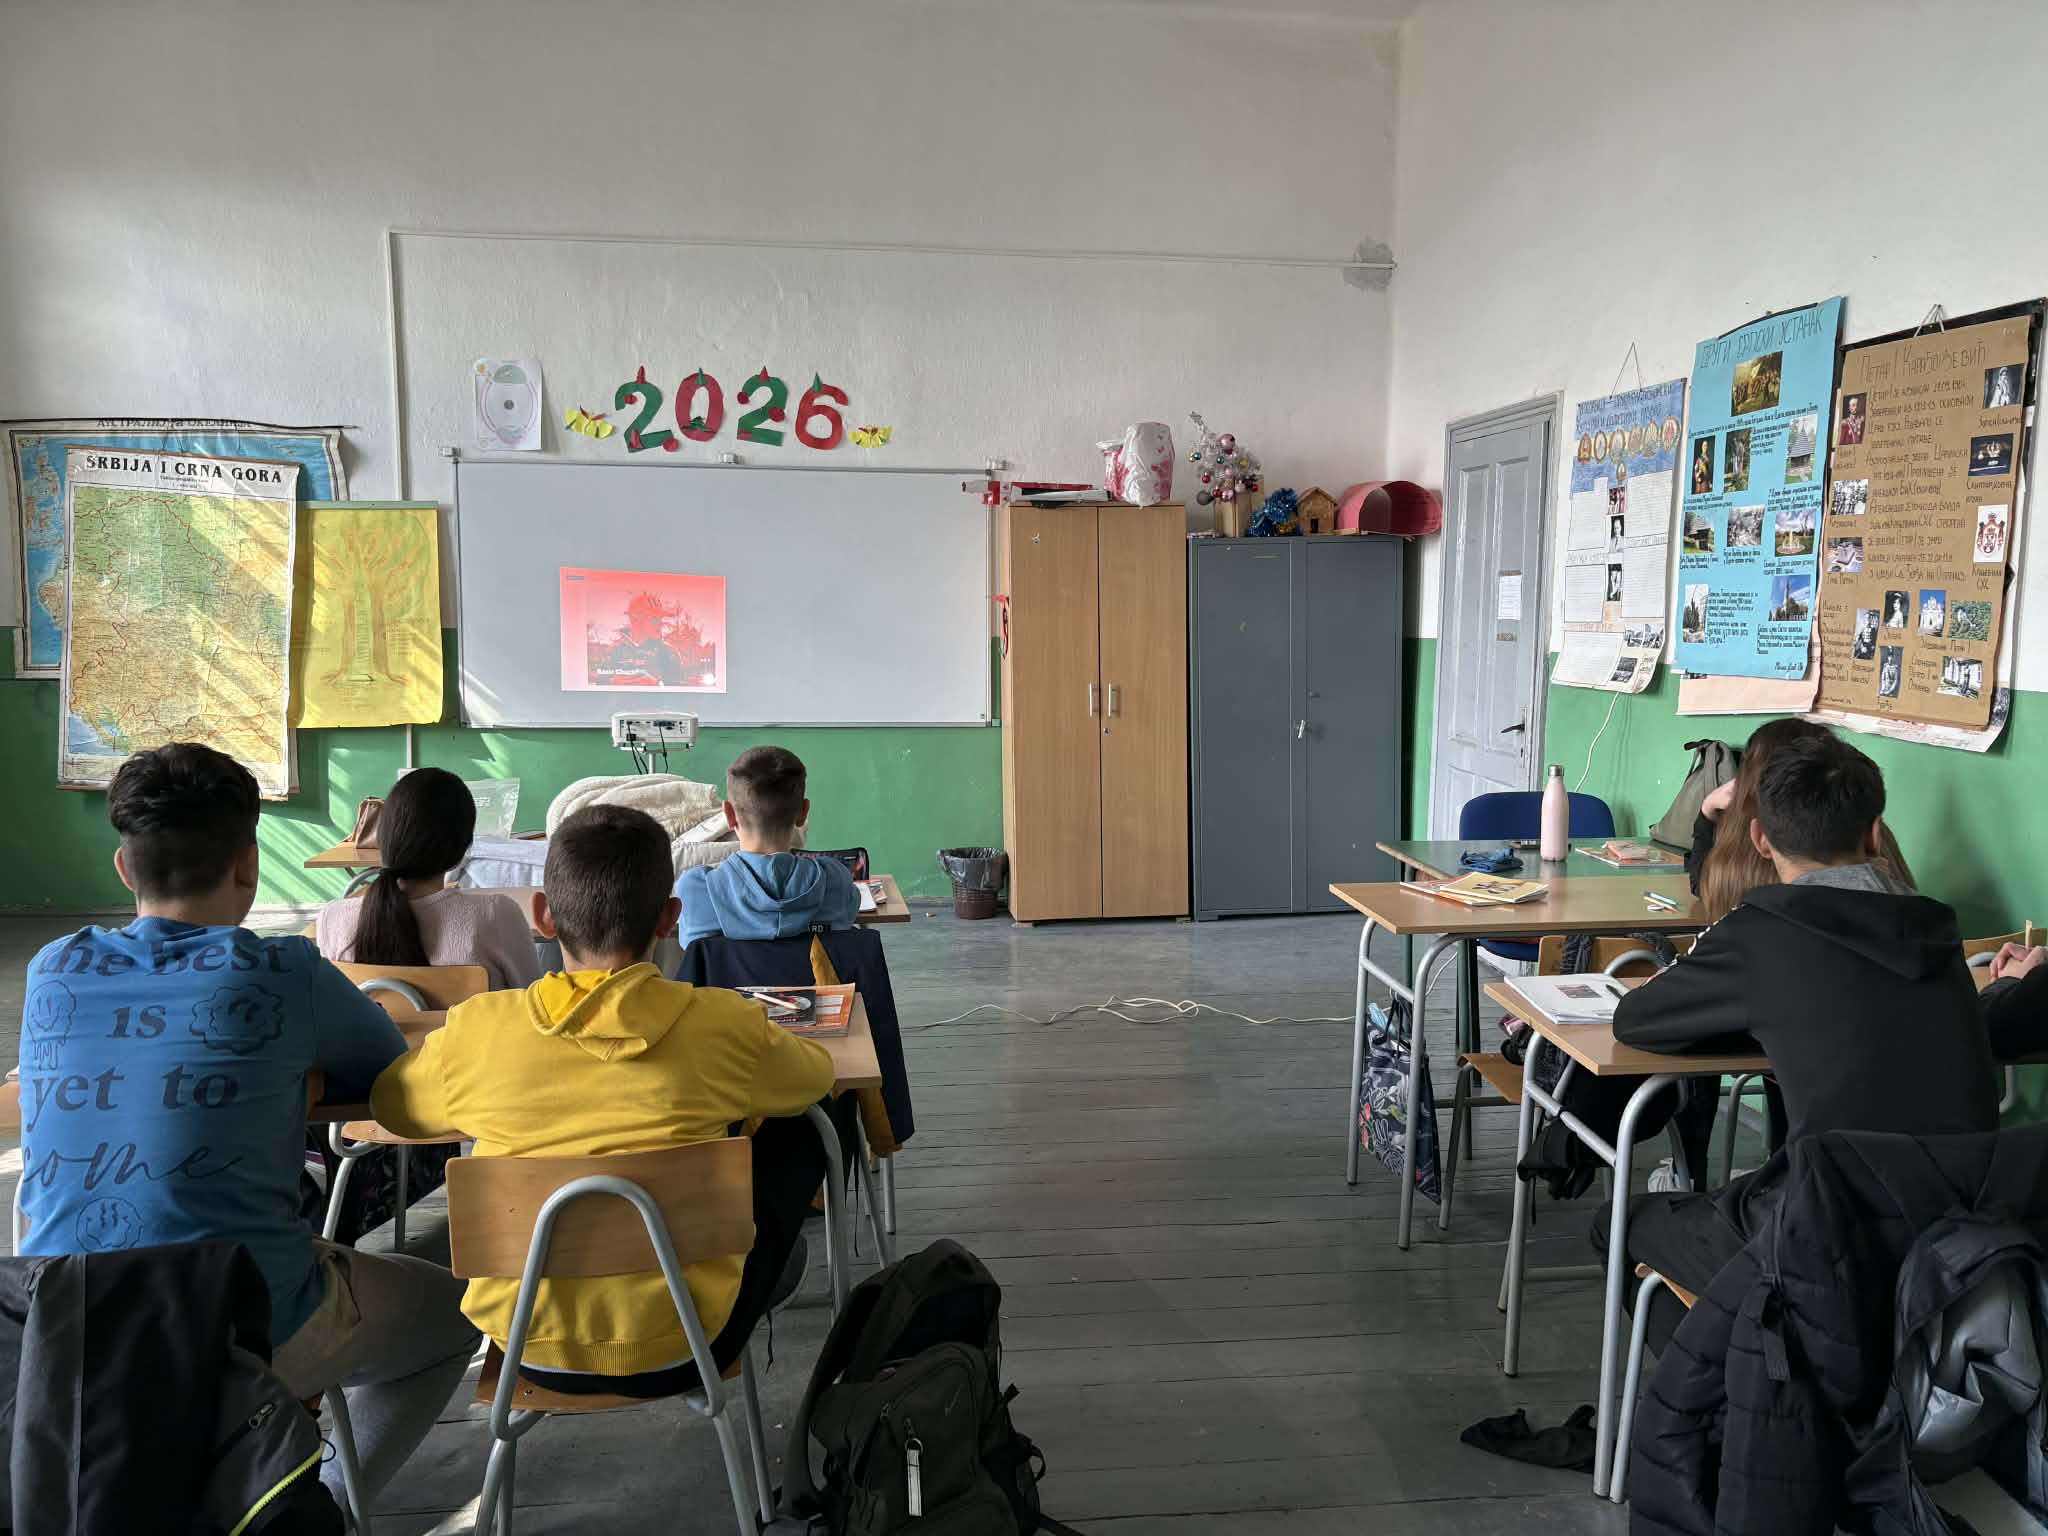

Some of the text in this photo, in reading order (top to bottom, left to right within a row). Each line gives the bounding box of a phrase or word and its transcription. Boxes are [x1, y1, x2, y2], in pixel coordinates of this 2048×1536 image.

[614, 368, 849, 453] 2026
[86, 455, 281, 483] SRBIJA I CRNA GORA
[105, 1004, 167, 1038] is
[26, 1064, 240, 1132] yet to
